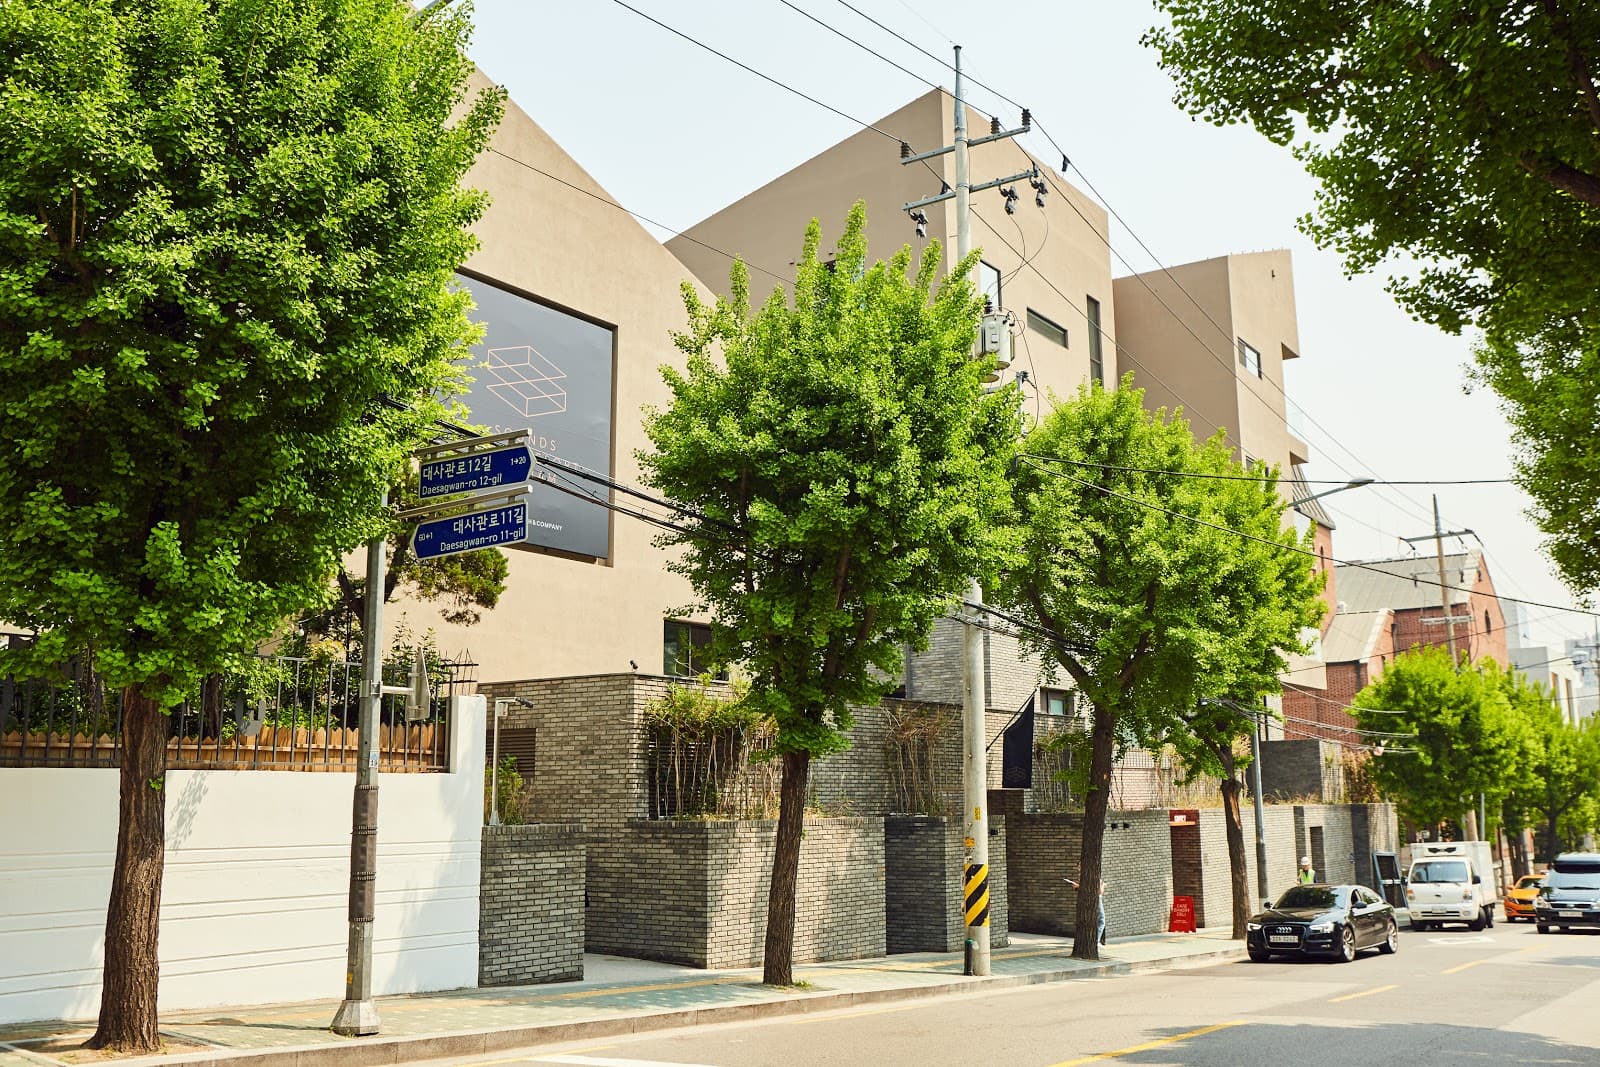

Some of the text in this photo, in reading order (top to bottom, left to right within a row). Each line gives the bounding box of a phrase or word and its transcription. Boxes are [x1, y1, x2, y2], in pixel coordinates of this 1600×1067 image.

[423, 455, 492, 480] 대사관로12길
[422, 473, 502, 495] Daesagwan-ro 12-gil
[453, 506, 524, 534] 대사관로11길
[440, 527, 524, 552] Daesagwan-ro 11-gil
